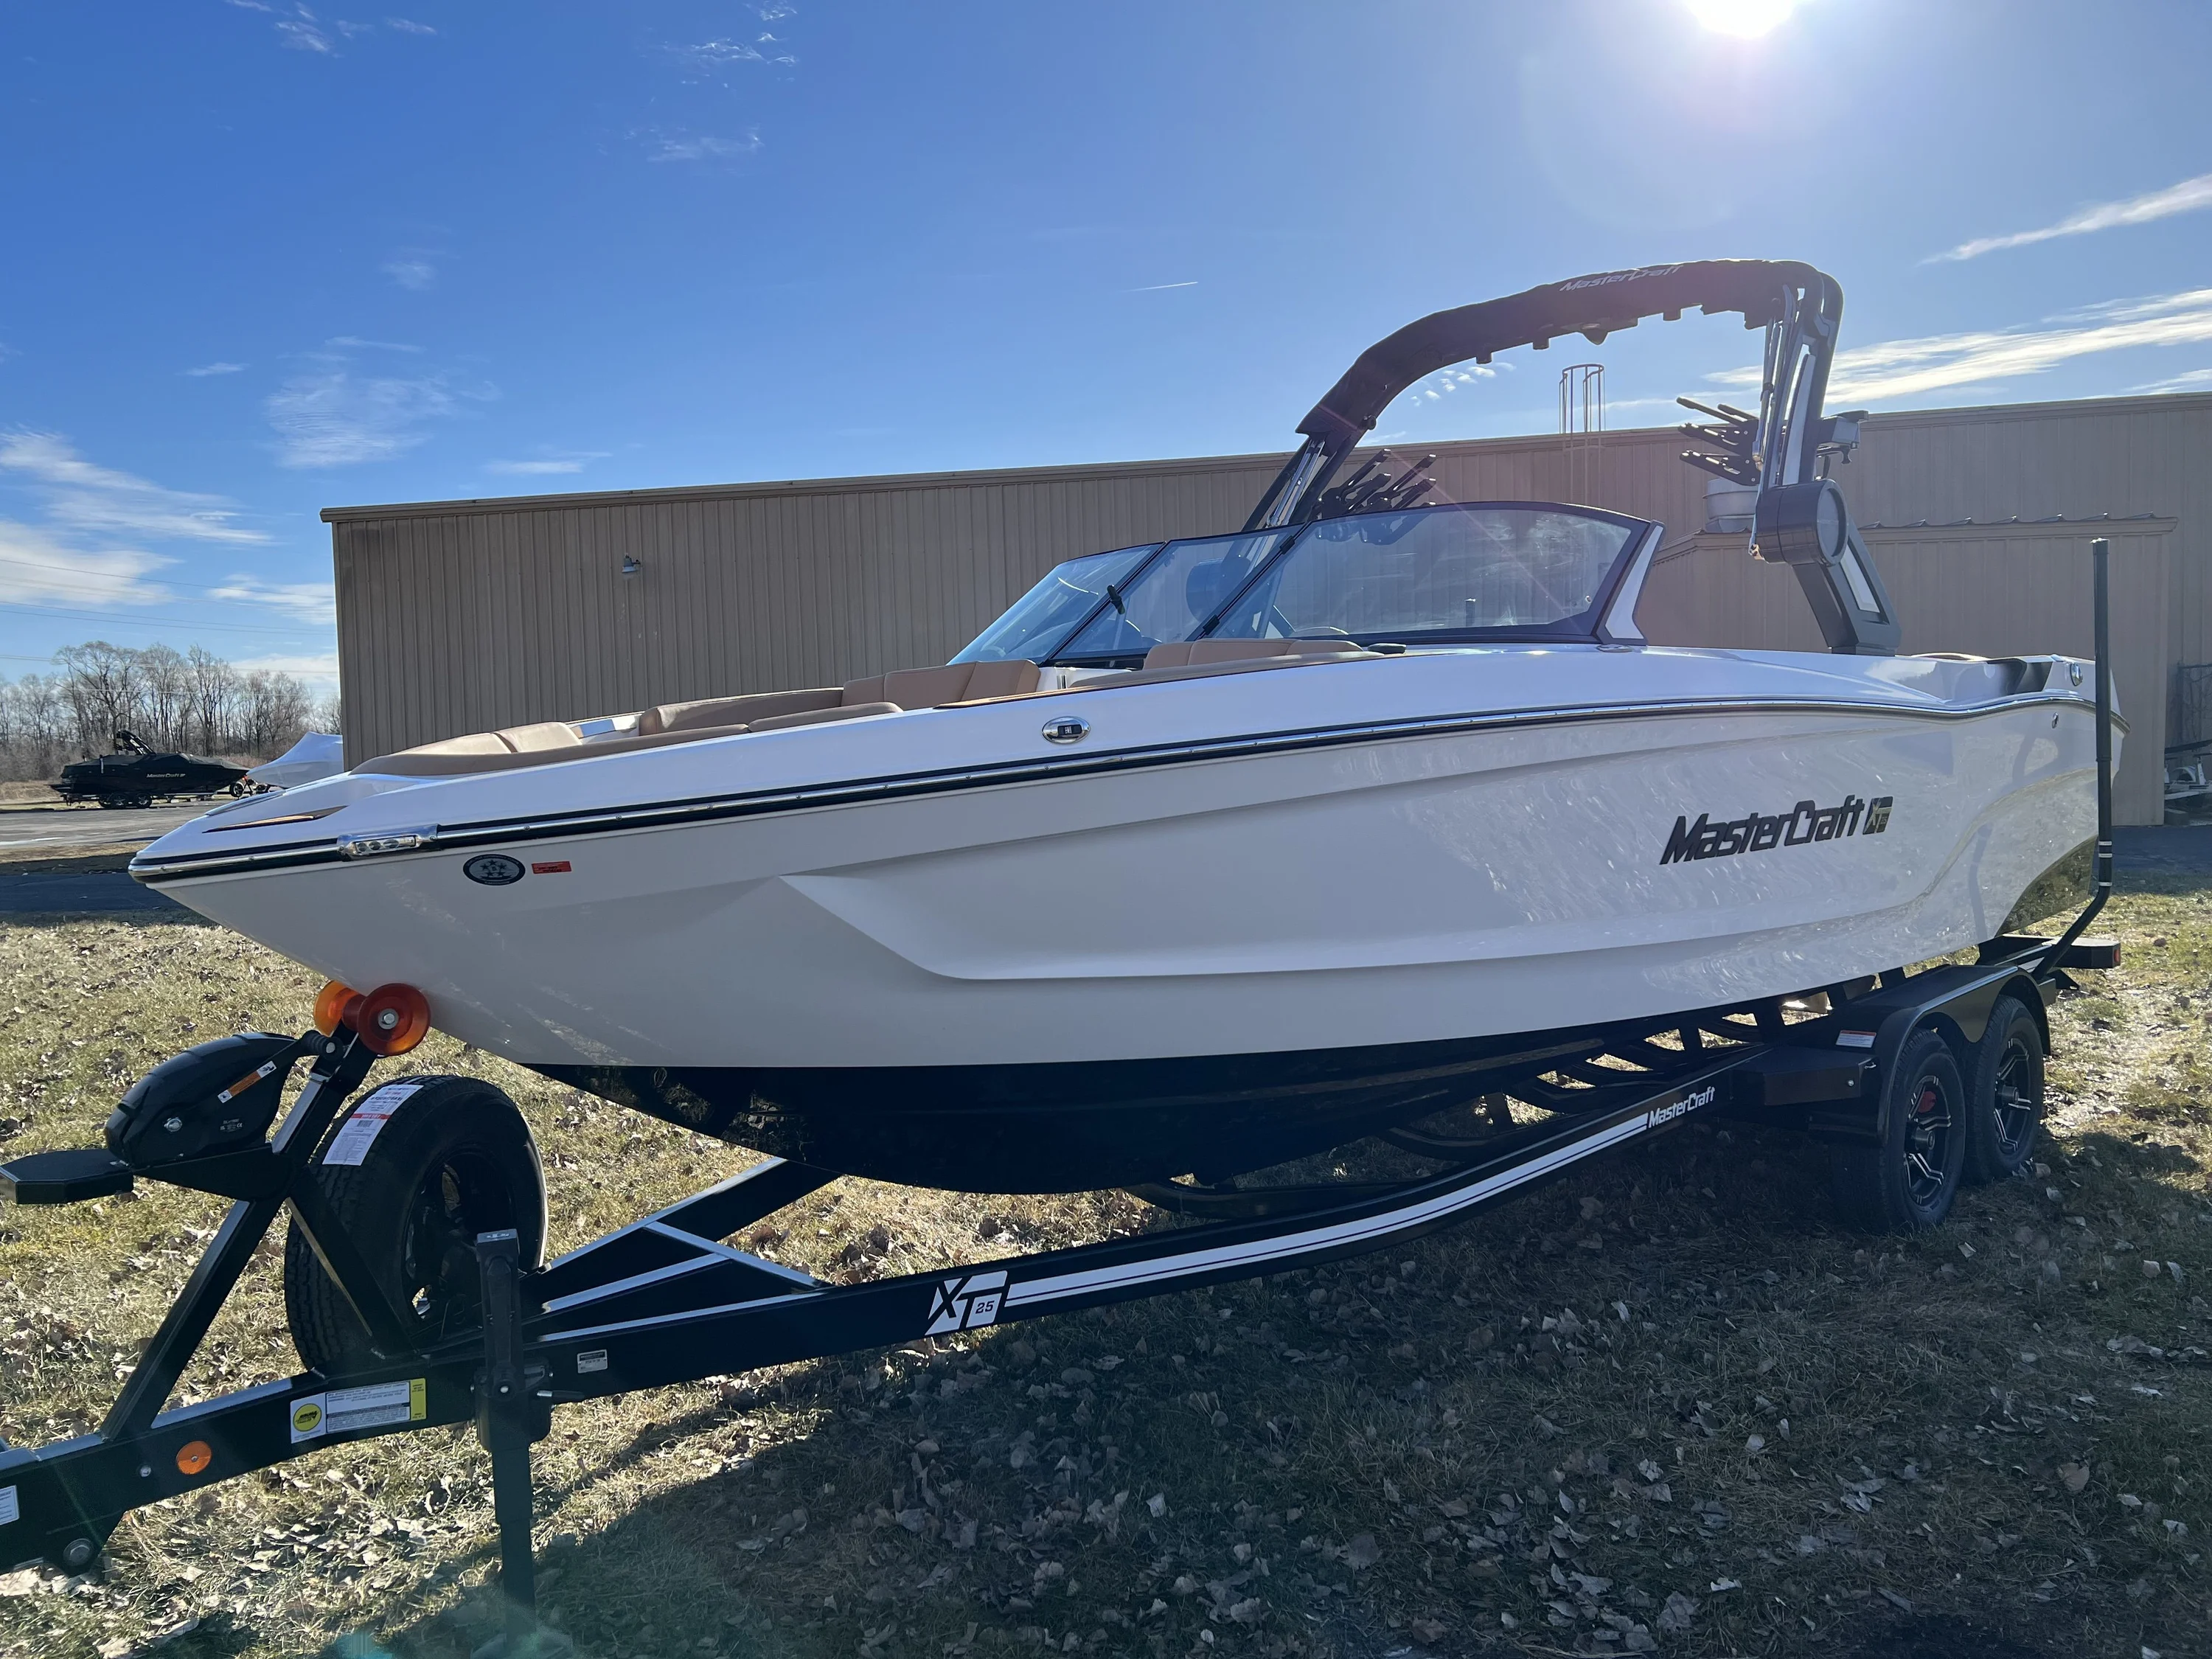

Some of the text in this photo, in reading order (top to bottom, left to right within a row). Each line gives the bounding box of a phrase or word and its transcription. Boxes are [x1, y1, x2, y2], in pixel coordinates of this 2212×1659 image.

[1559, 265, 1684, 292] MasterCraft
[1659, 795, 1865, 865] MasterCraft
[1648, 1085, 1716, 1128] MasterCraft
[925, 1275, 1005, 1335] XT 25
